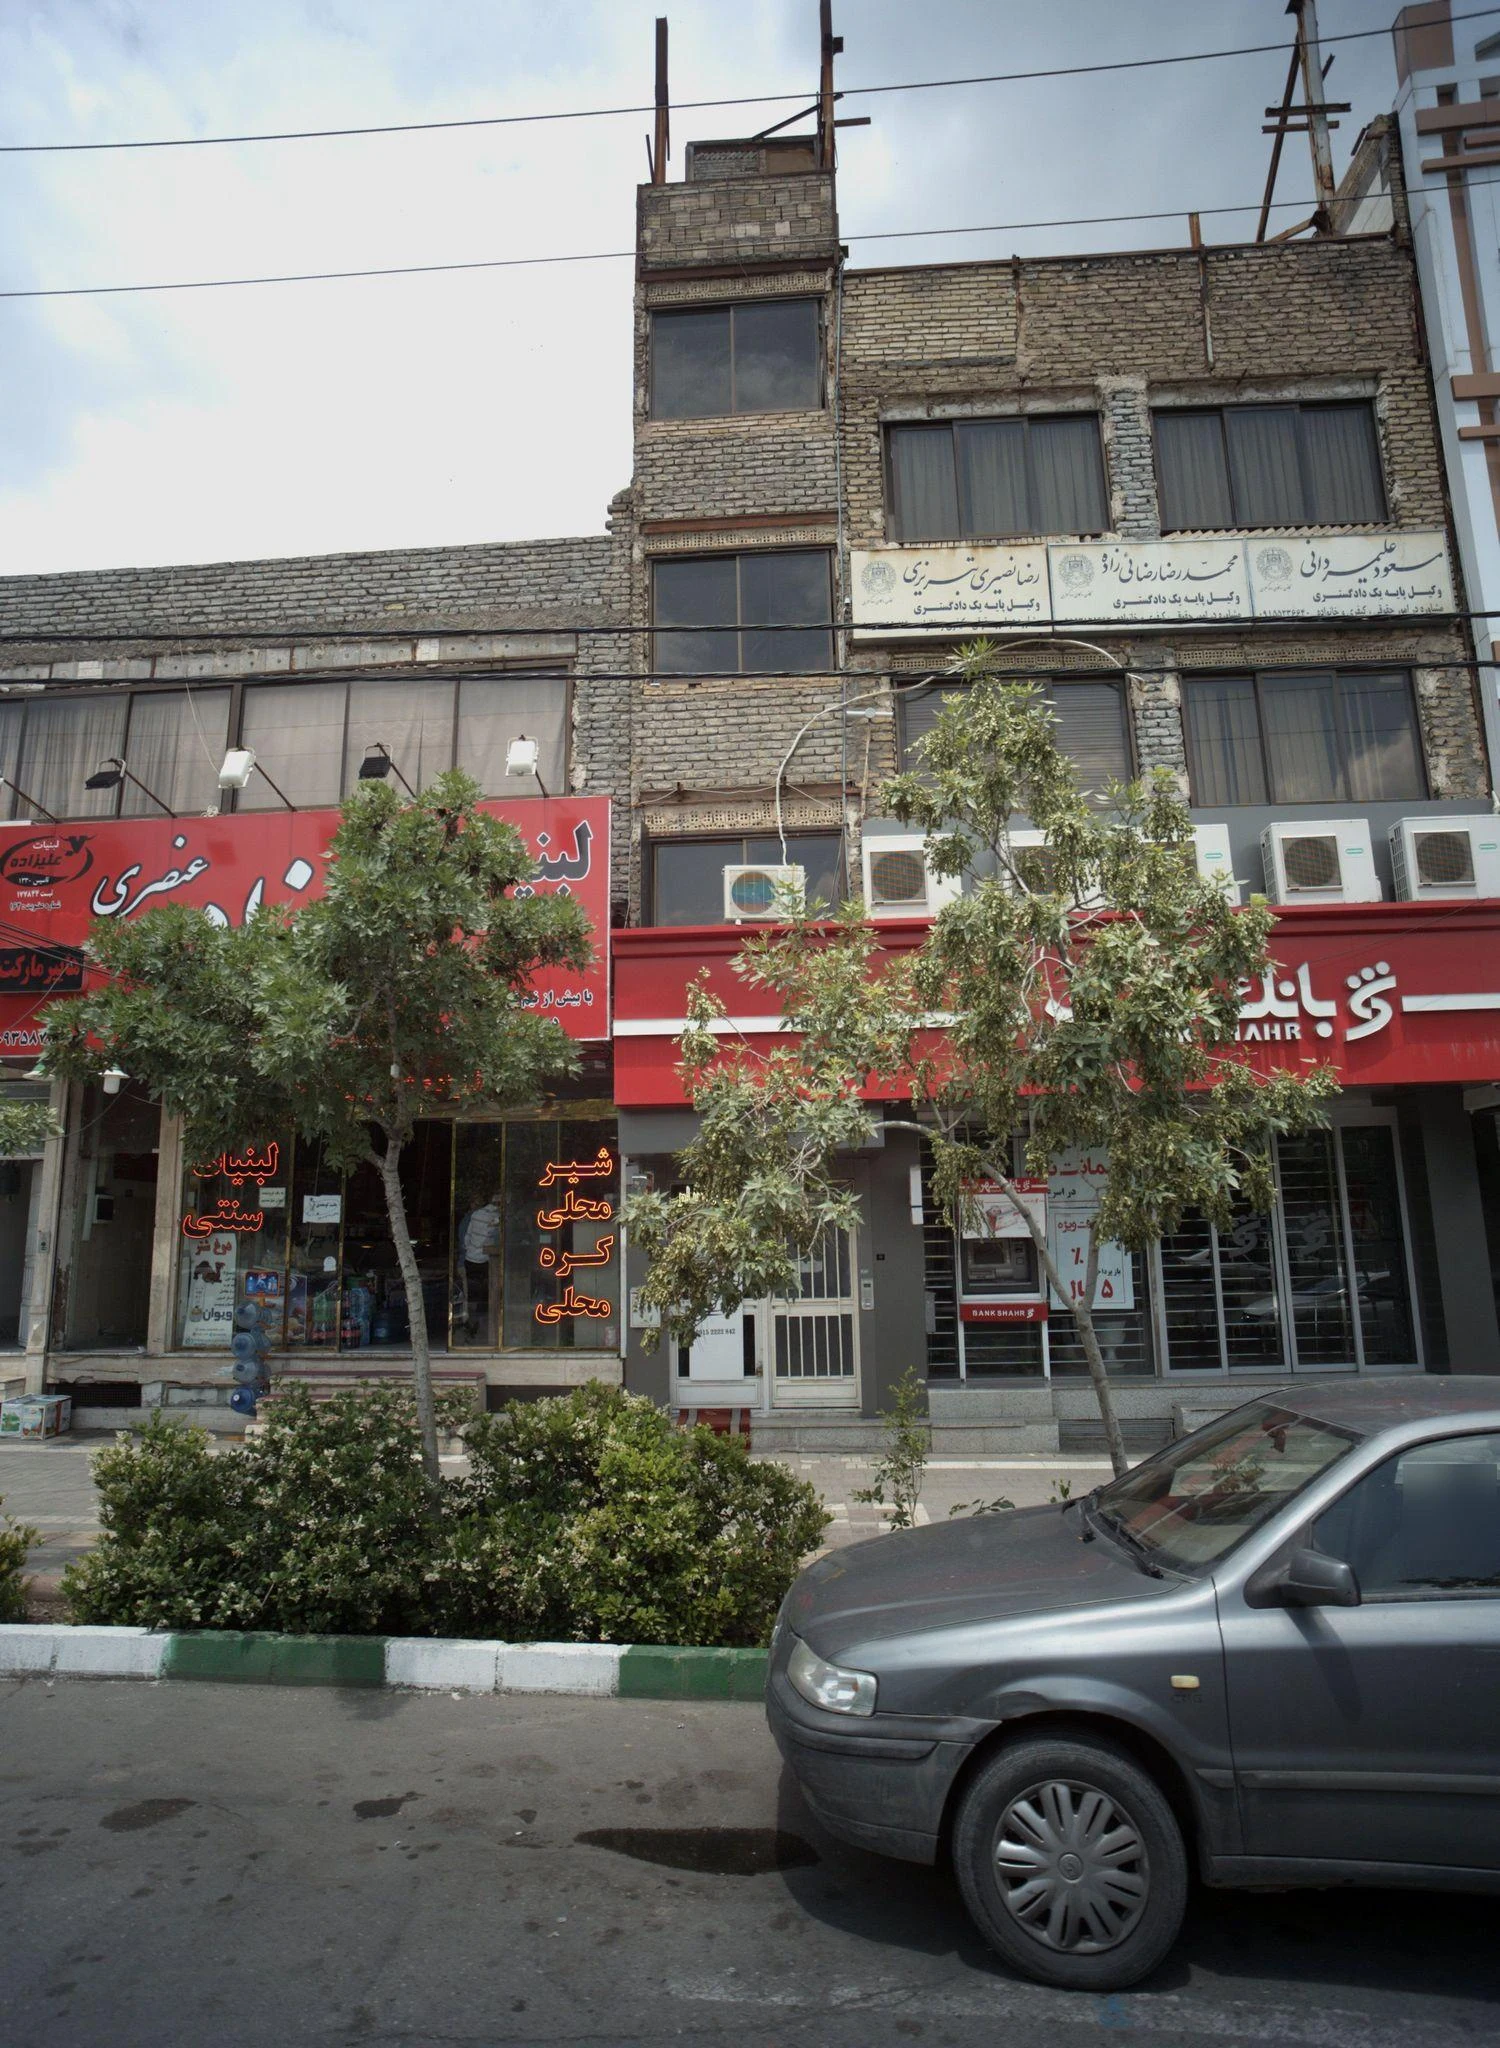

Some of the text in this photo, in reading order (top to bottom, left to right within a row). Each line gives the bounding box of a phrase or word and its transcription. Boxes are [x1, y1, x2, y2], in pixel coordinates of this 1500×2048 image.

[902, 555, 1040, 596] رضا نصیری تبریزی
[1112, 591, 1240, 609] وکیل پایه یک دادگستری
[1312, 584, 1442, 603] وکیل پایه یک دادگستری
[913, 598, 1040, 616] وکیل پایه یک دادگستری
[0, 953, 44, 985] مارکت
[540, 989, 554, 1009] از
[555, 989, 581, 1008] بیش
[582, 988, 593, 1006] با
[538, 1147, 614, 1186] شیر
[182, 1199, 264, 1239] سنتی
[537, 1190, 612, 1230] محلی
[539, 1235, 614, 1277] کره
[535, 1286, 611, 1324] محلی
[997, 1309, 1026, 1317] SHAHR
